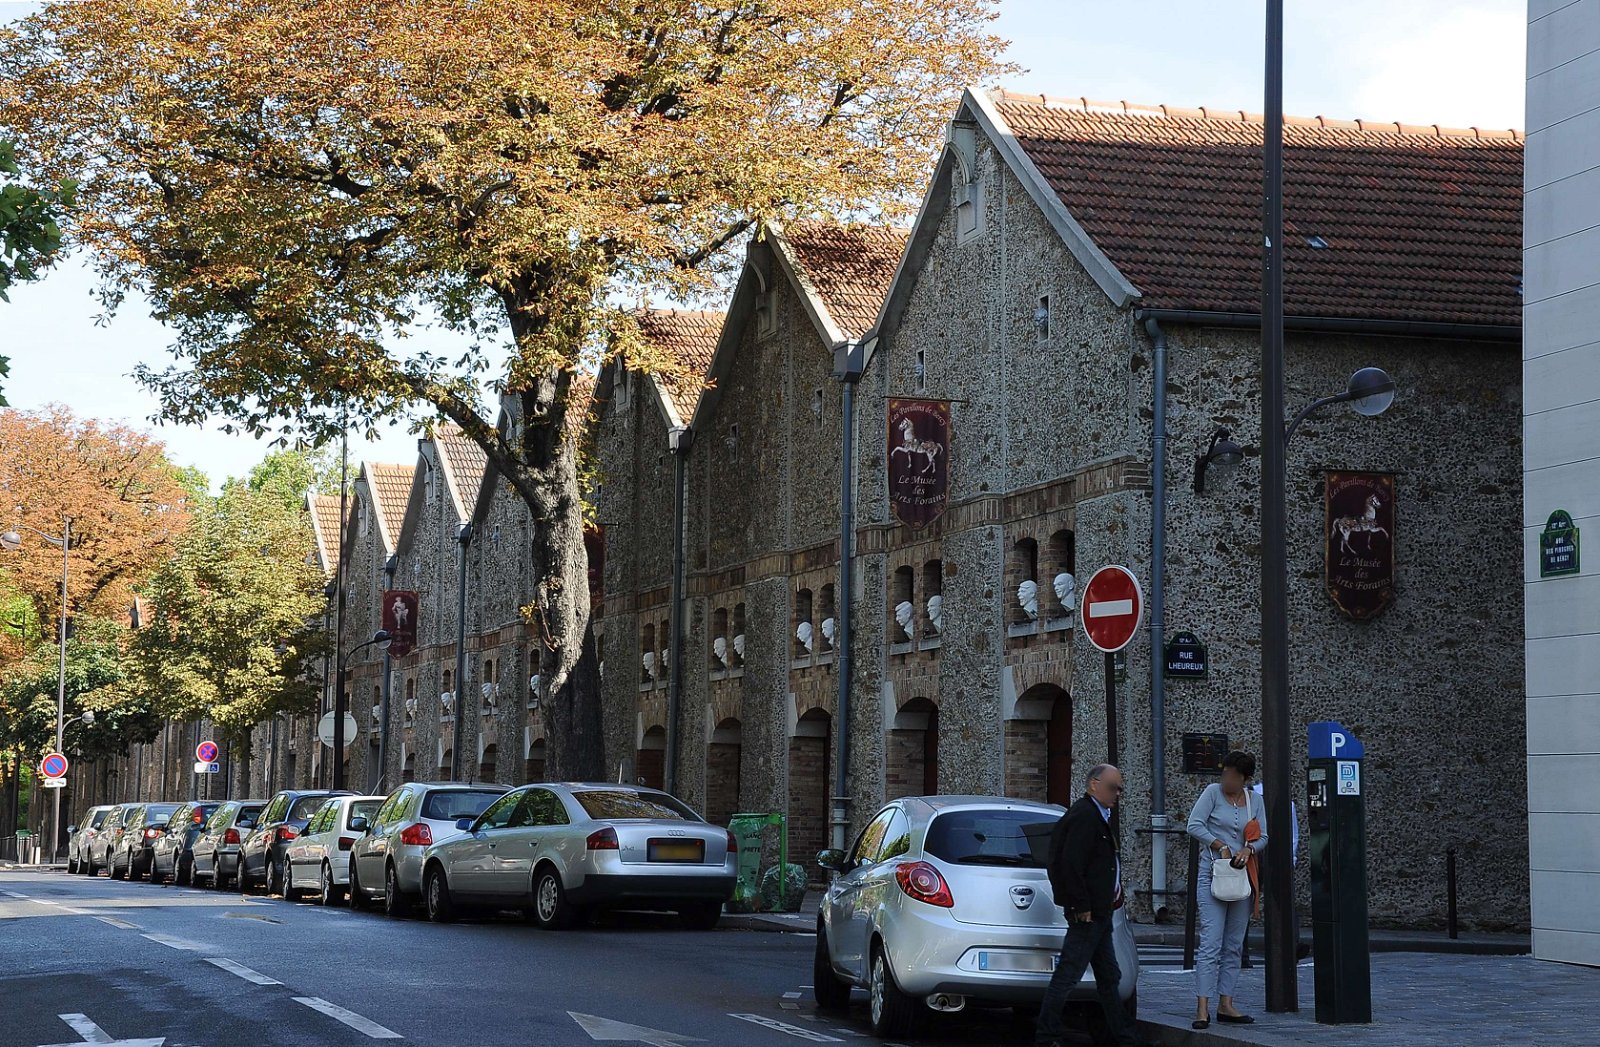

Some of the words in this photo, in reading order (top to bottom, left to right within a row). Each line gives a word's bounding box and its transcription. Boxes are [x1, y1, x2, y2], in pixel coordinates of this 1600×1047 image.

[898, 475, 910, 484] Le
[911, 475, 937, 485] Musée
[912, 485, 926, 495] des
[892, 491, 911, 504] Arts
[914, 492, 946, 505] Forains
[1339, 556, 1351, 566] Le
[1352, 557, 1381, 568] Musée
[1354, 568, 1369, 579] des
[1355, 576, 1391, 590] Forains
[1179, 651, 1194, 660] RUE
[1168, 661, 1204, 671] LHEUREUX
[1331, 732, 1346, 757] P
